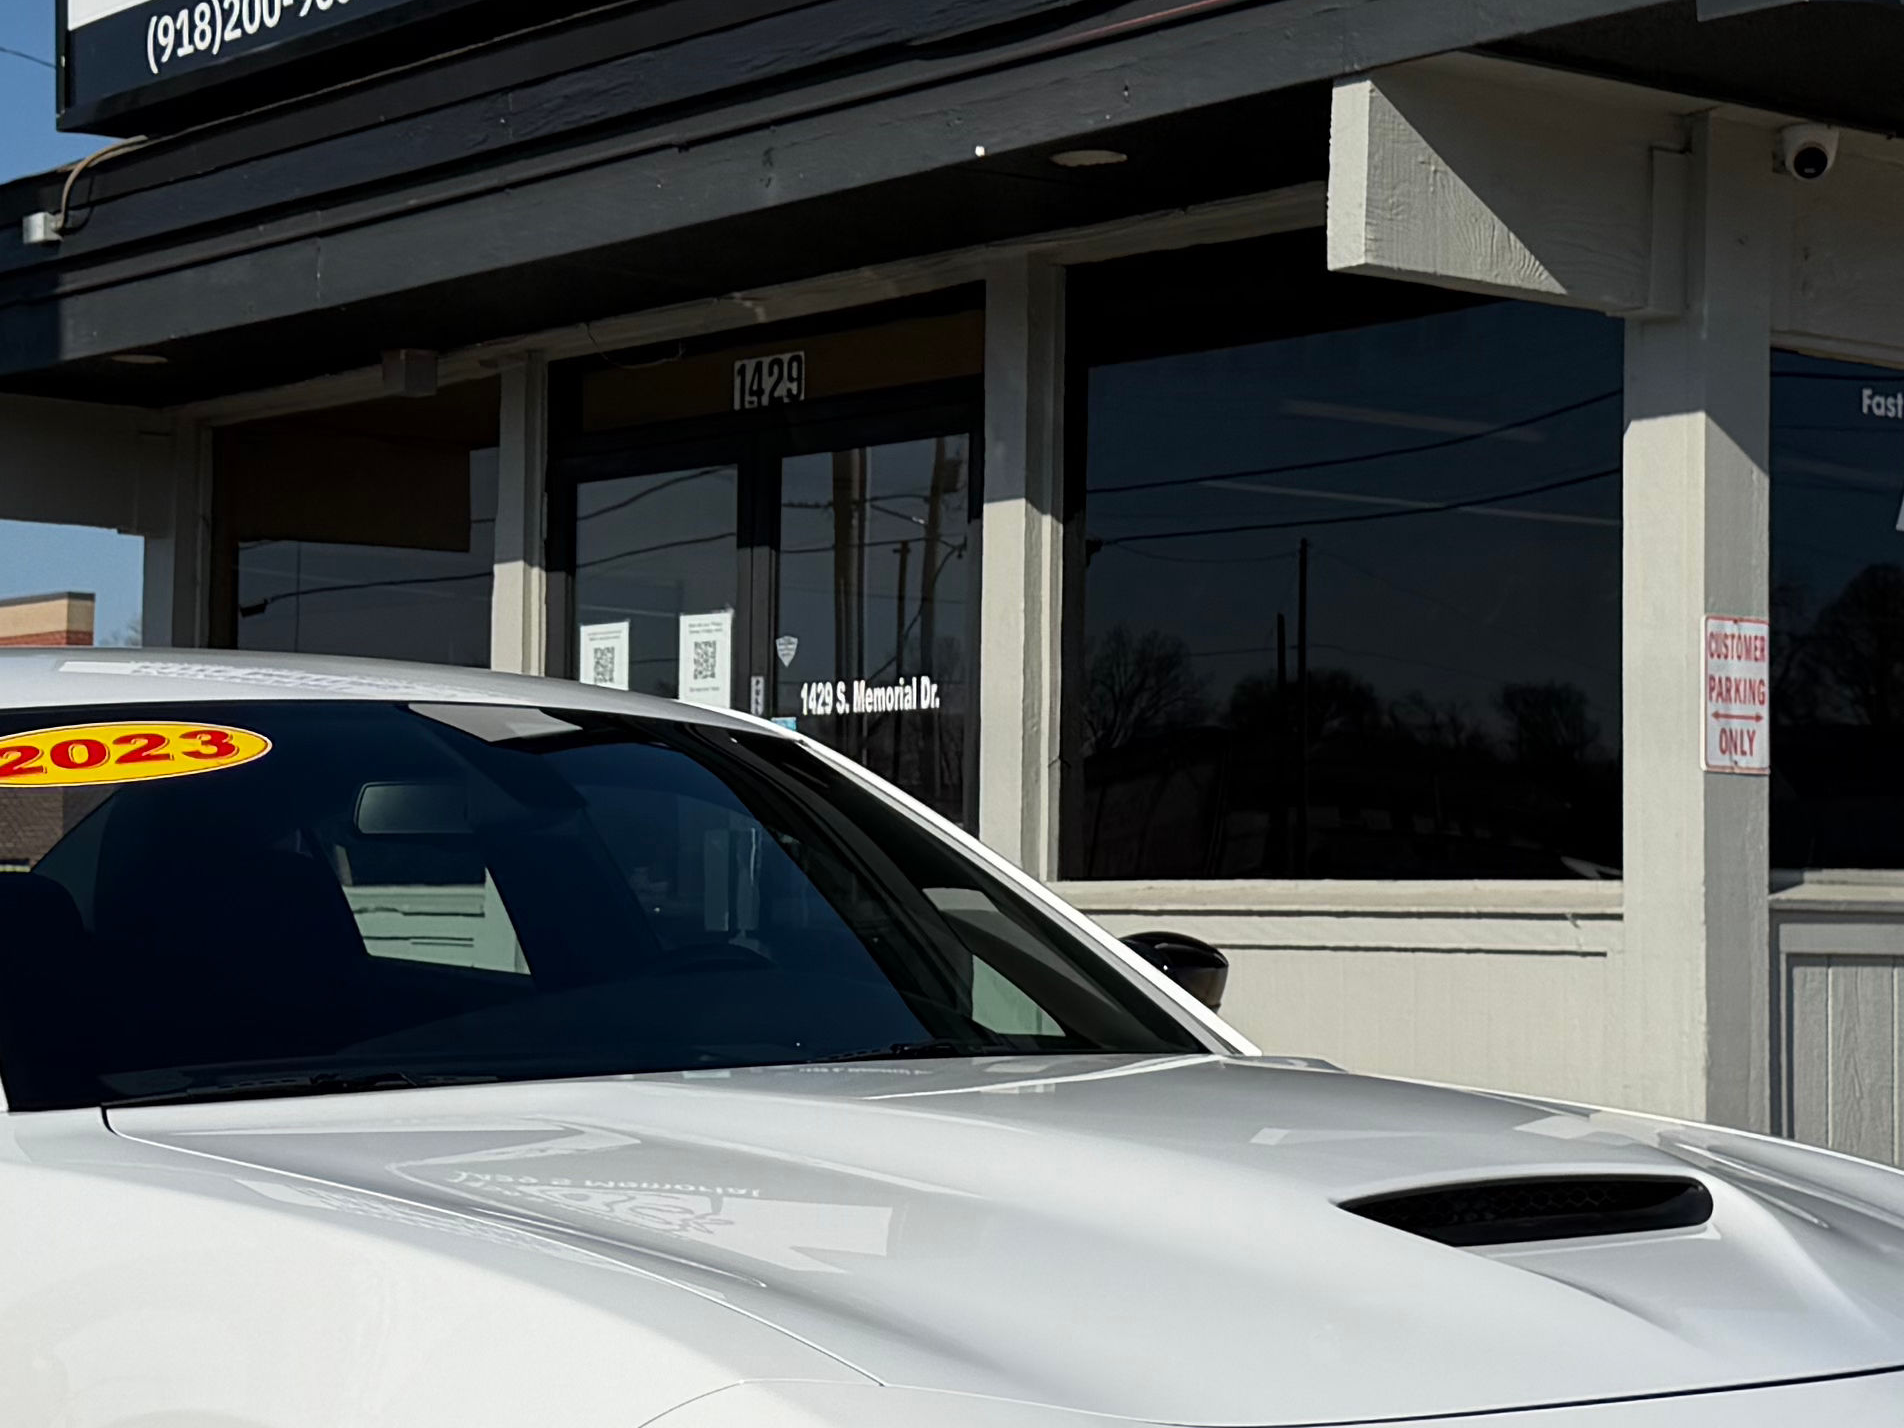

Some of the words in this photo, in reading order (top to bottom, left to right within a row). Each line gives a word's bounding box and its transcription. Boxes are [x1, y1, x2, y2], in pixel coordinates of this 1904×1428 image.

[737, 354, 803, 410] 1429
[1862, 388, 1903, 420] Fast
[1708, 632, 1766, 663] CUSTOMER
[800, 681, 833, 716] 1429
[836, 680, 850, 715] S.
[853, 677, 917, 713] Memorial
[920, 675, 940, 709] Dr.
[1708, 675, 1766, 706] PARKING
[1719, 728, 1756, 757] ONLY
